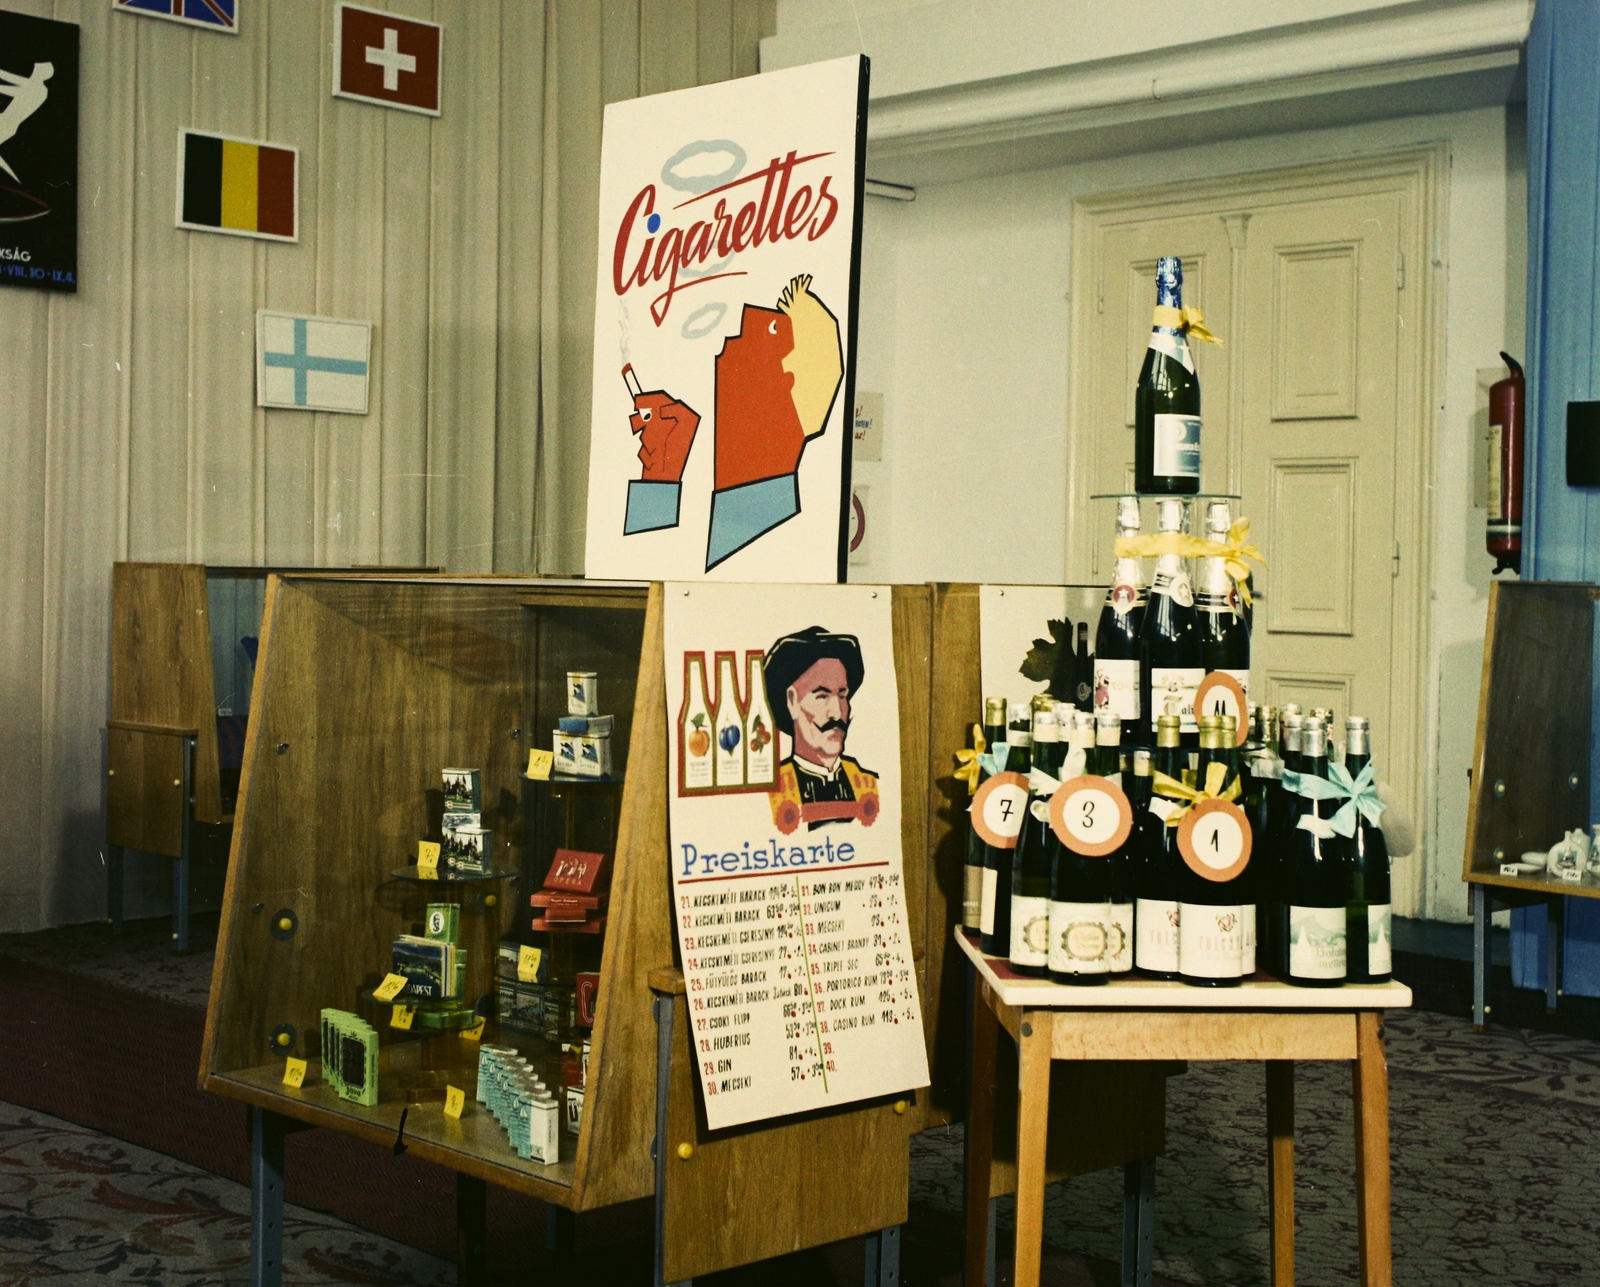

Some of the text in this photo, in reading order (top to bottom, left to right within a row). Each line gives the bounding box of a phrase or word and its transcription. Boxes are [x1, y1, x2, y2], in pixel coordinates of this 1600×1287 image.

[613, 150, 838, 328] Cigarettes
[1000, 799, 1013, 822] 7
[1082, 801, 1095, 828] 3
[1210, 829, 1219, 852] 1
[681, 836, 855, 876] Preiskarte
[553, 877, 582, 886] OPERA
[740, 889, 766, 902] BARACK
[734, 909, 760, 921] BARACK
[814, 900, 841, 914] UNICUM
[819, 940, 844, 955] CABINET
[847, 937, 869, 951] BRANDY
[811, 963, 821, 975] 35.
[823, 960, 843, 974] TRIPLE
[847, 958, 859, 971] SEC
[691, 978, 705, 991] 25.
[741, 971, 767, 985] BARACK
[814, 983, 825, 994] 36.
[826, 976, 861, 992] PORTORICO
[864, 974, 878, 987] RUM
[694, 998, 706, 1011] 26.
[746, 990, 769, 1004] BARACK
[830, 998, 847, 1011] DOCK
[850, 995, 866, 1007] RUM
[709, 1016, 730, 1030] CSOKI
[733, 1013, 751, 1026] FLIPP
[820, 1021, 831, 1033] 38.
[833, 1017, 858, 1032] CASINO
[861, 1013, 876, 1027] RUM
[700, 1039, 712, 1052] 28.
[713, 1033, 751, 1050] HUBERTUS
[823, 1042, 835, 1055] 39.
[704, 1062, 717, 1075] 29.
[718, 1059, 732, 1073] GIN
[826, 1060, 838, 1073] 40.
[708, 1082, 719, 1095] 30.
